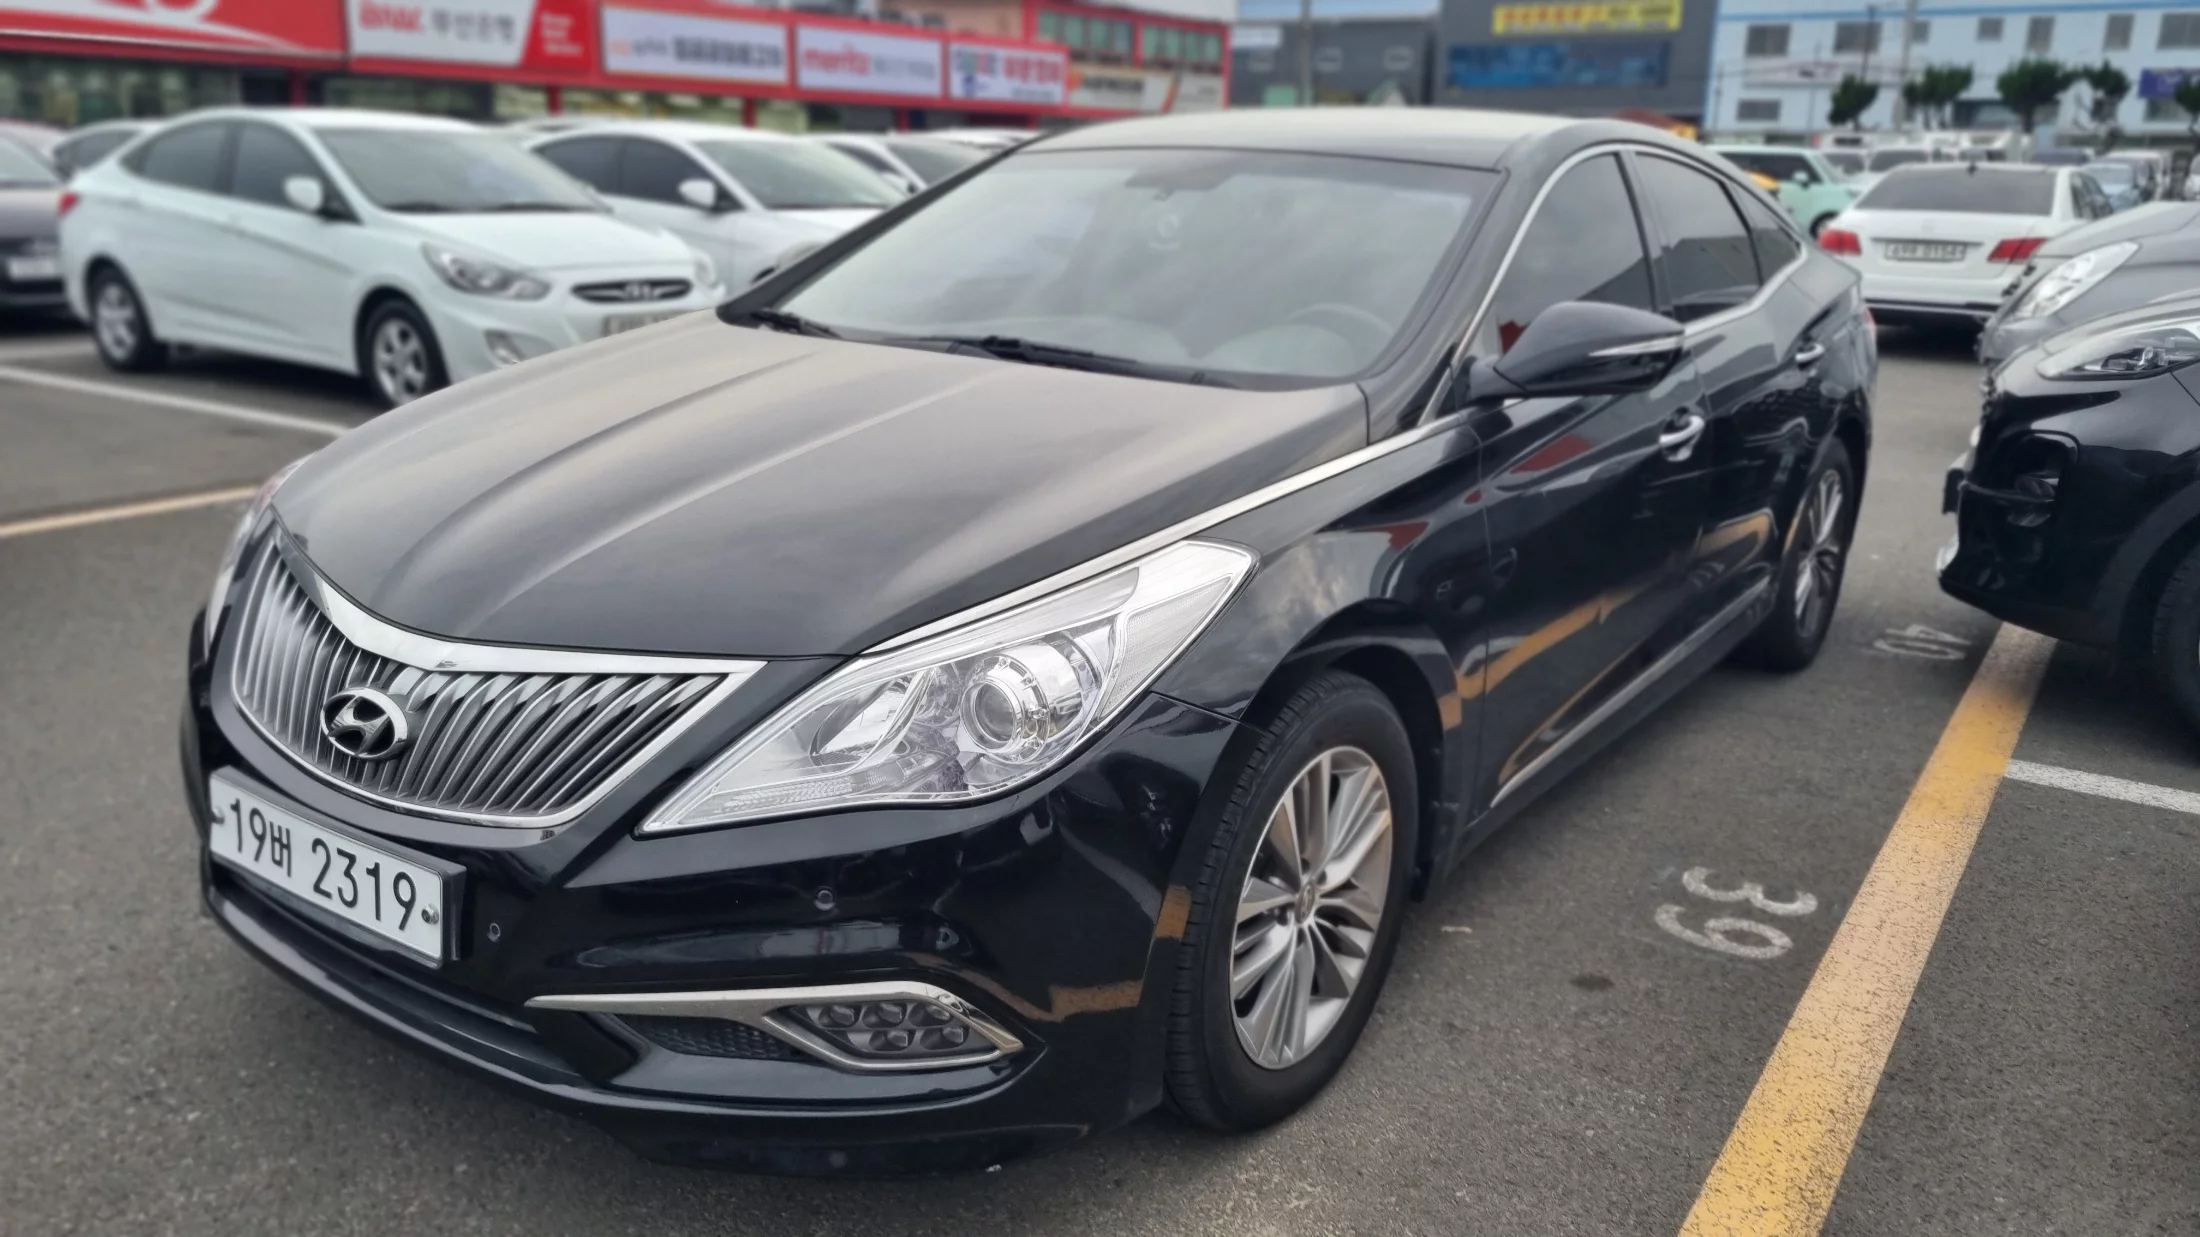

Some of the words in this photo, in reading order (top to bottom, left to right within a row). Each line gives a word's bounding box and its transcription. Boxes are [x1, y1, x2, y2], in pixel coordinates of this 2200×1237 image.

[230, 798, 292, 878] 19버
[311, 837, 417, 932] 2319
[1655, 866, 1819, 960] 39
